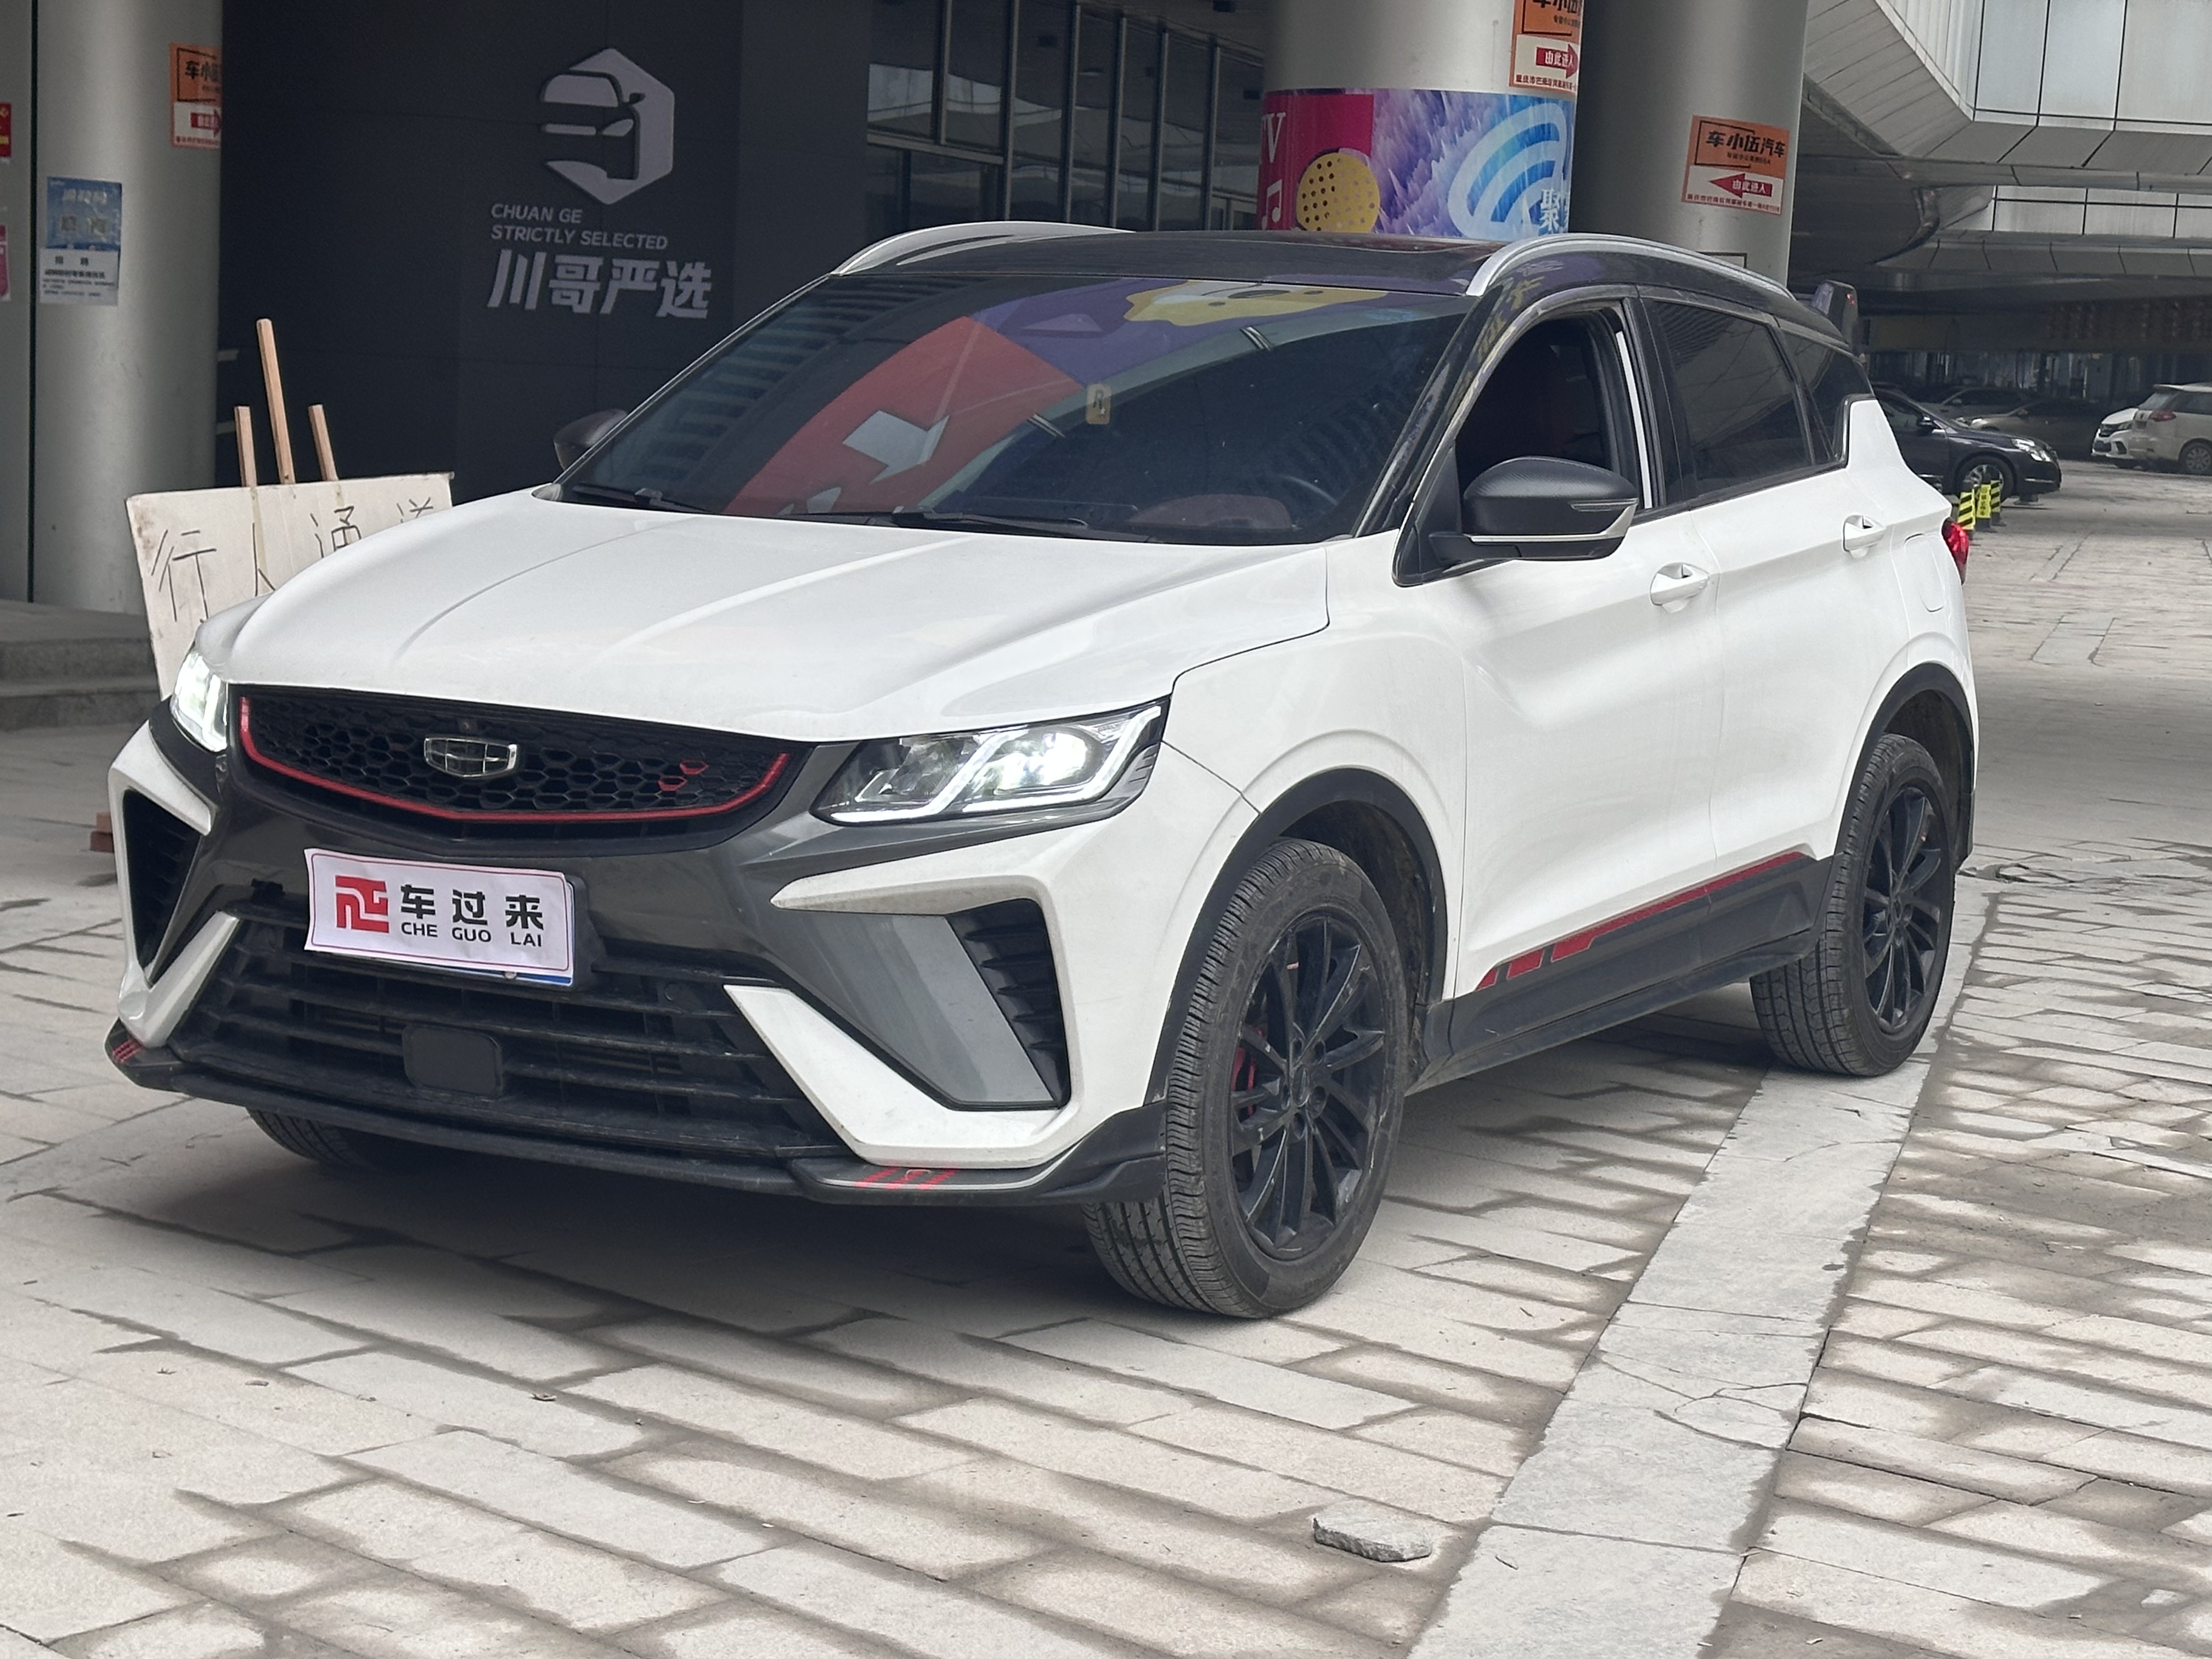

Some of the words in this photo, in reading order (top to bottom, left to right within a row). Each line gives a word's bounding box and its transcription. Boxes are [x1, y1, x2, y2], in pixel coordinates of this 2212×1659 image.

[1706, 130, 1786, 158] 车小伍汽车
[490, 204, 553, 222] CHUAN
[558, 207, 583, 224] GE
[491, 224, 576, 245] STRICTLY
[580, 230, 668, 250] SELECTED
[487, 248, 712, 320] 川哥严选
[150, 496, 435, 622] 行人通
[400, 884, 544, 931] 车过来
[401, 922, 438, 938] CHE
[452, 927, 492, 943] GUO
[510, 932, 542, 947] LAI
